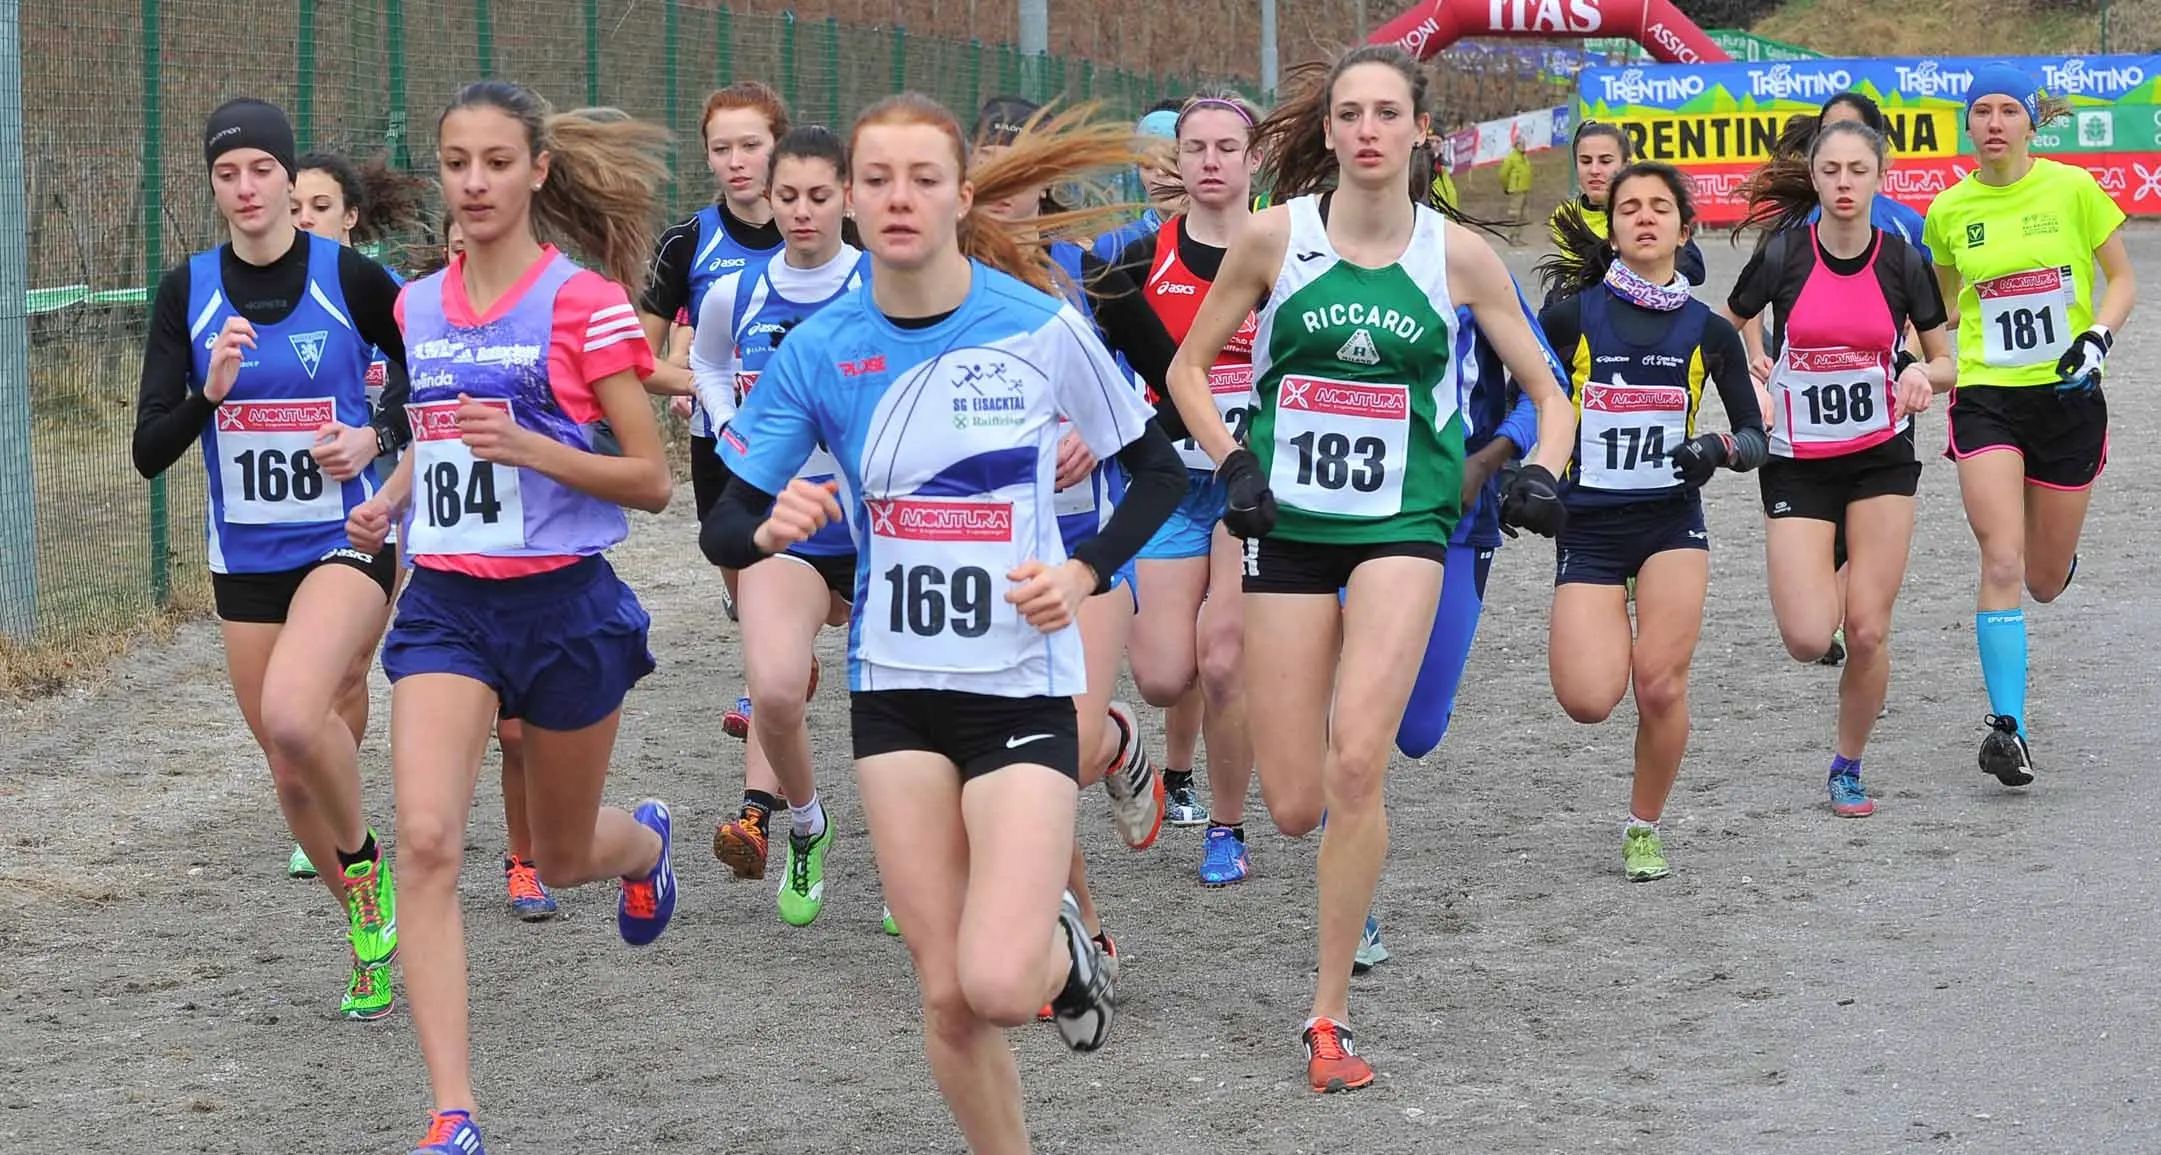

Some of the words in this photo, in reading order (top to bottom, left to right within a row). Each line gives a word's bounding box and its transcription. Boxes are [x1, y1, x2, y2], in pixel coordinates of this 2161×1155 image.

[1489, 0, 1602, 32] ITAS
[1600, 74, 1704, 104] TRENTINO
[1748, 69, 1851, 98] TRENTINO
[2042, 65, 2145, 90] TRENTINO
[1167, 283, 1197, 295] asics
[1303, 303, 1425, 344] RICCARDI
[1995, 306, 2055, 351] 181
[953, 398, 968, 412] SG
[1315, 387, 1405, 408] MONTURA
[1611, 392, 1684, 405] MONTURA
[1802, 382, 1874, 425] 198
[248, 405, 332, 423] MONTURA
[1290, 431, 1387, 493] 183
[1599, 426, 1667, 470] 174
[234, 449, 324, 502] 168
[424, 461, 502, 528] 184
[900, 508, 1009, 528] MONTURA
[884, 563, 993, 639] 169
